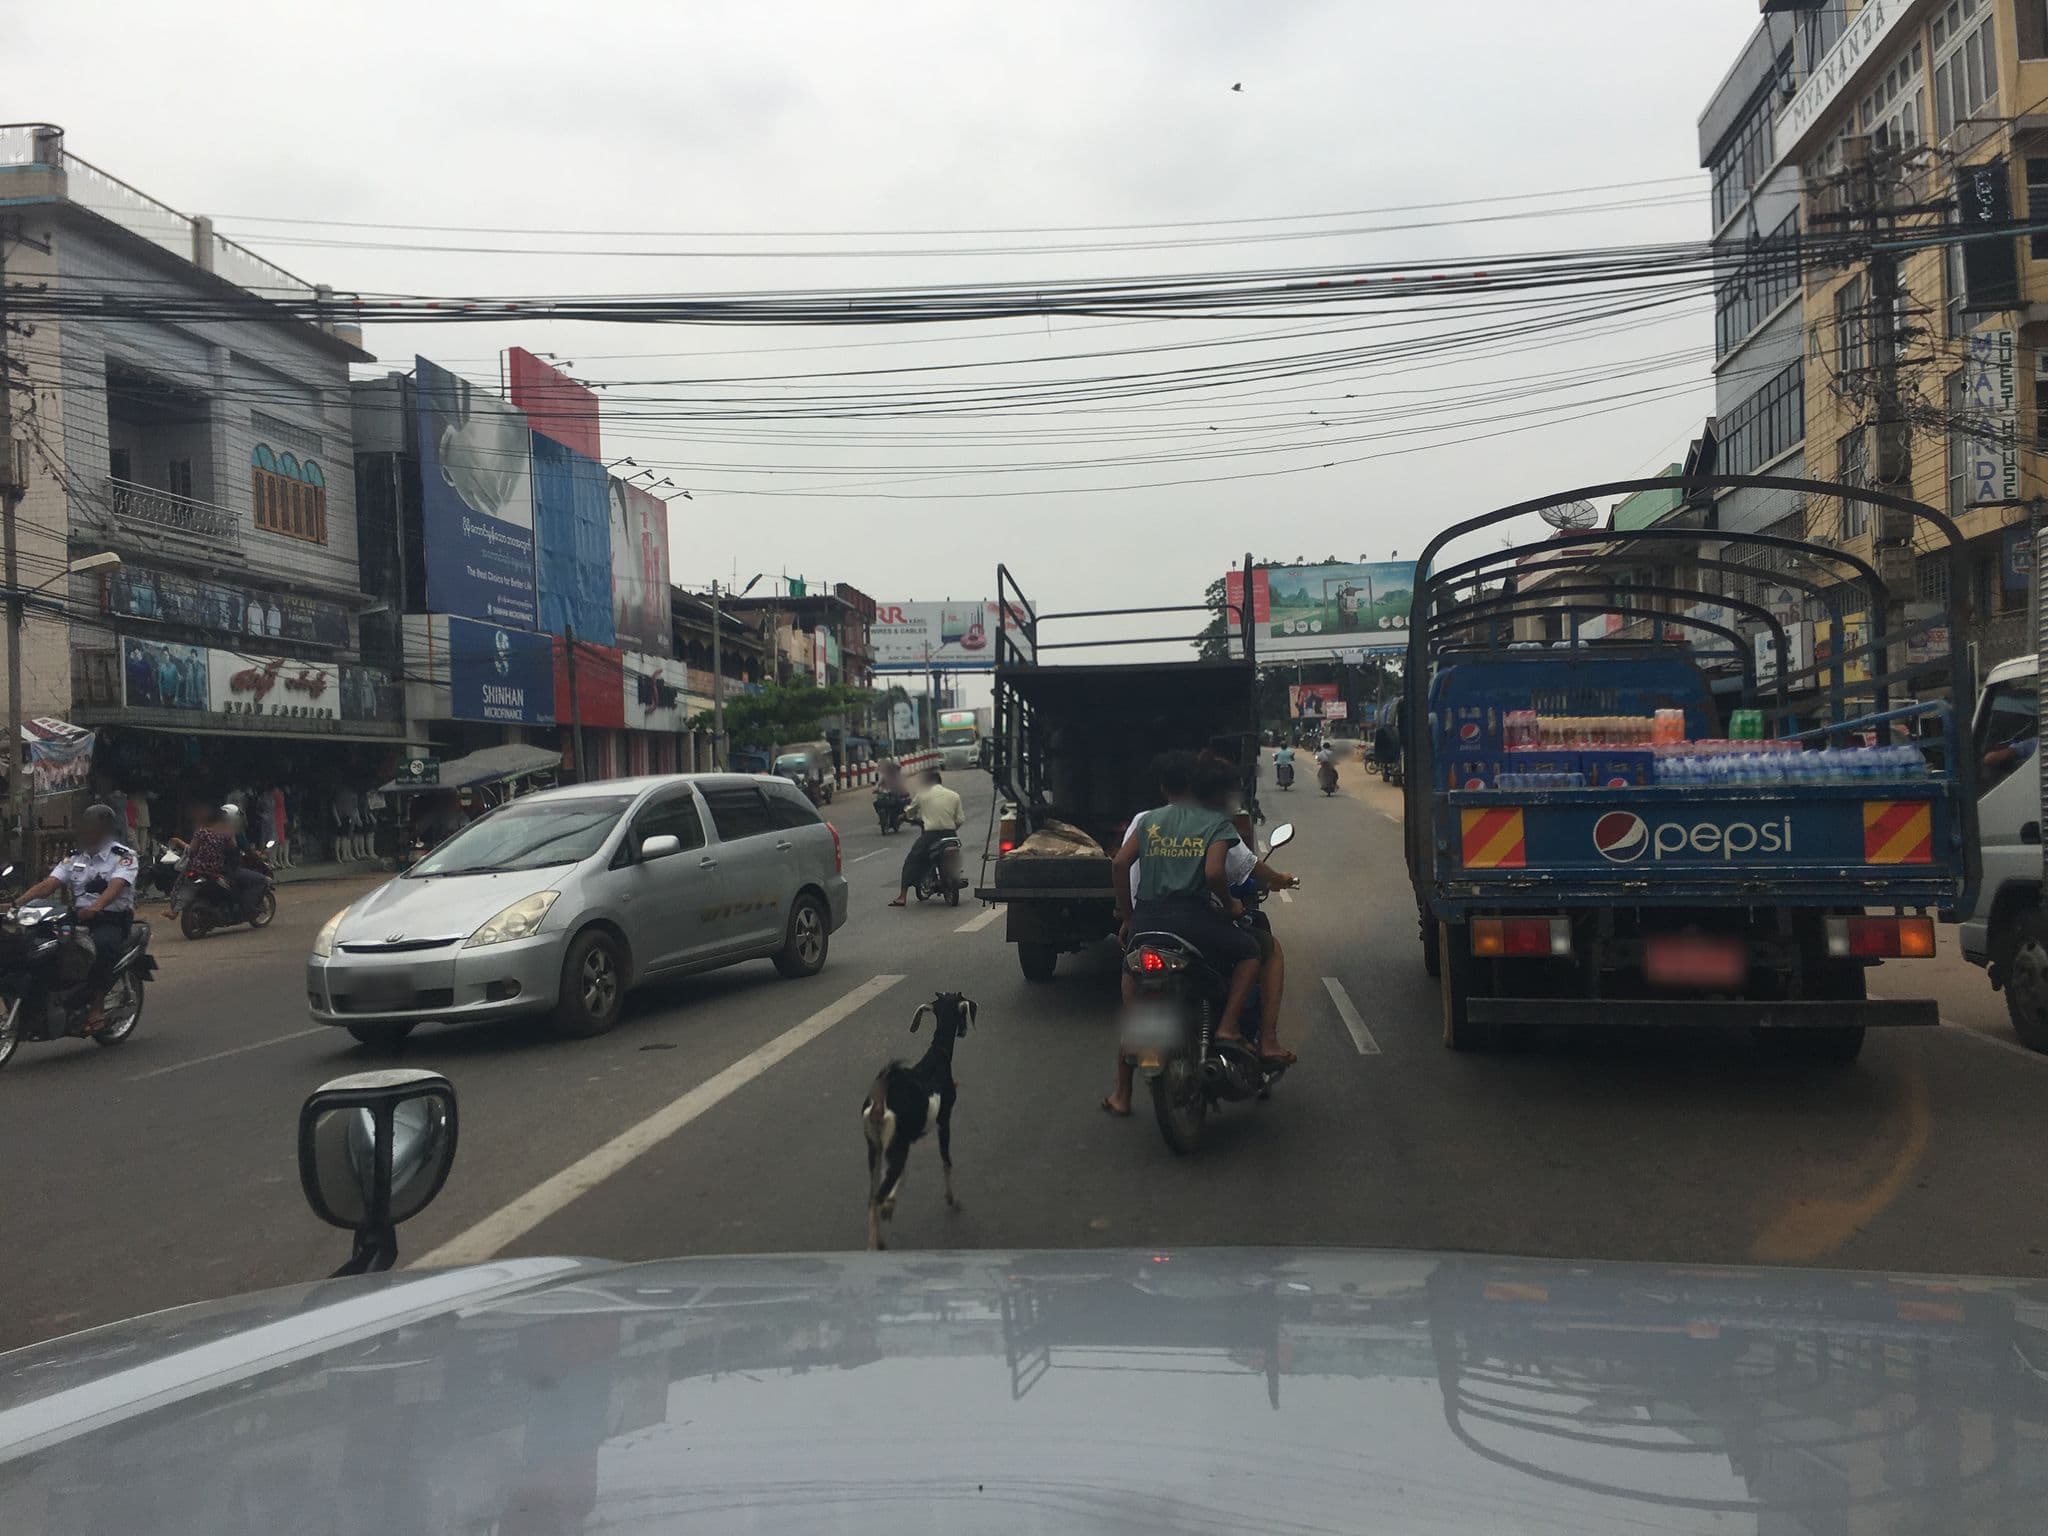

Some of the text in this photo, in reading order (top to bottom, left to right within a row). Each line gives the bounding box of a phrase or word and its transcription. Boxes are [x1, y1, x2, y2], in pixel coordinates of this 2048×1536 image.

[1999, 331, 2014, 410] GUEST
[482, 684, 524, 707] SHINHAN
[484, 706, 524, 720] MICROFINANCE
[1151, 836, 1204, 848] POLAR
[1654, 815, 1792, 861] pepsi
[1145, 848, 1205, 857] LUBRICANTS
